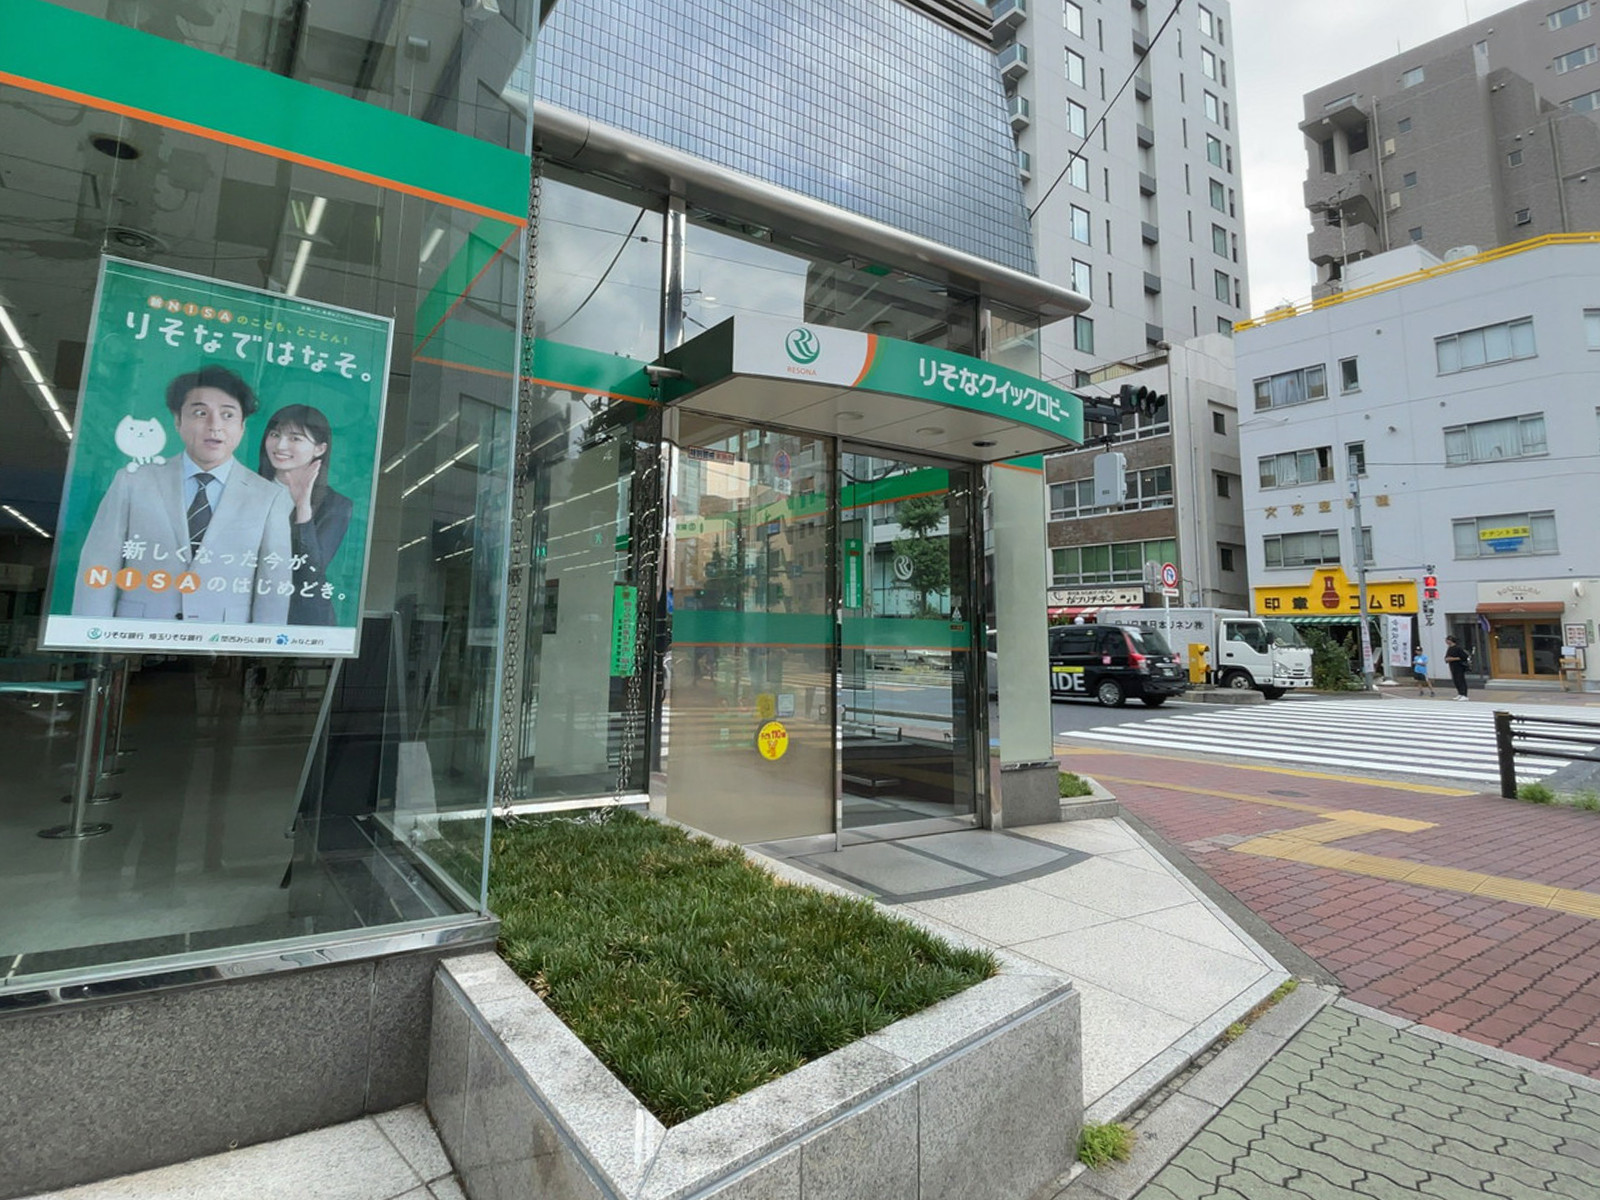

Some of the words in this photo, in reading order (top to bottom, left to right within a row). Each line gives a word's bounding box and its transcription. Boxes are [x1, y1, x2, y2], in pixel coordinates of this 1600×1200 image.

[126, 311, 371, 382] りそなではなそ。
[786, 365, 817, 376] RESONA
[919, 357, 1070, 422] りそなクイックロビー
[122, 537, 317, 572] 新しくなった今が、
[86, 567, 346, 600] NISAのはじめどき。
[103, 631, 144, 640] りそな銀行
